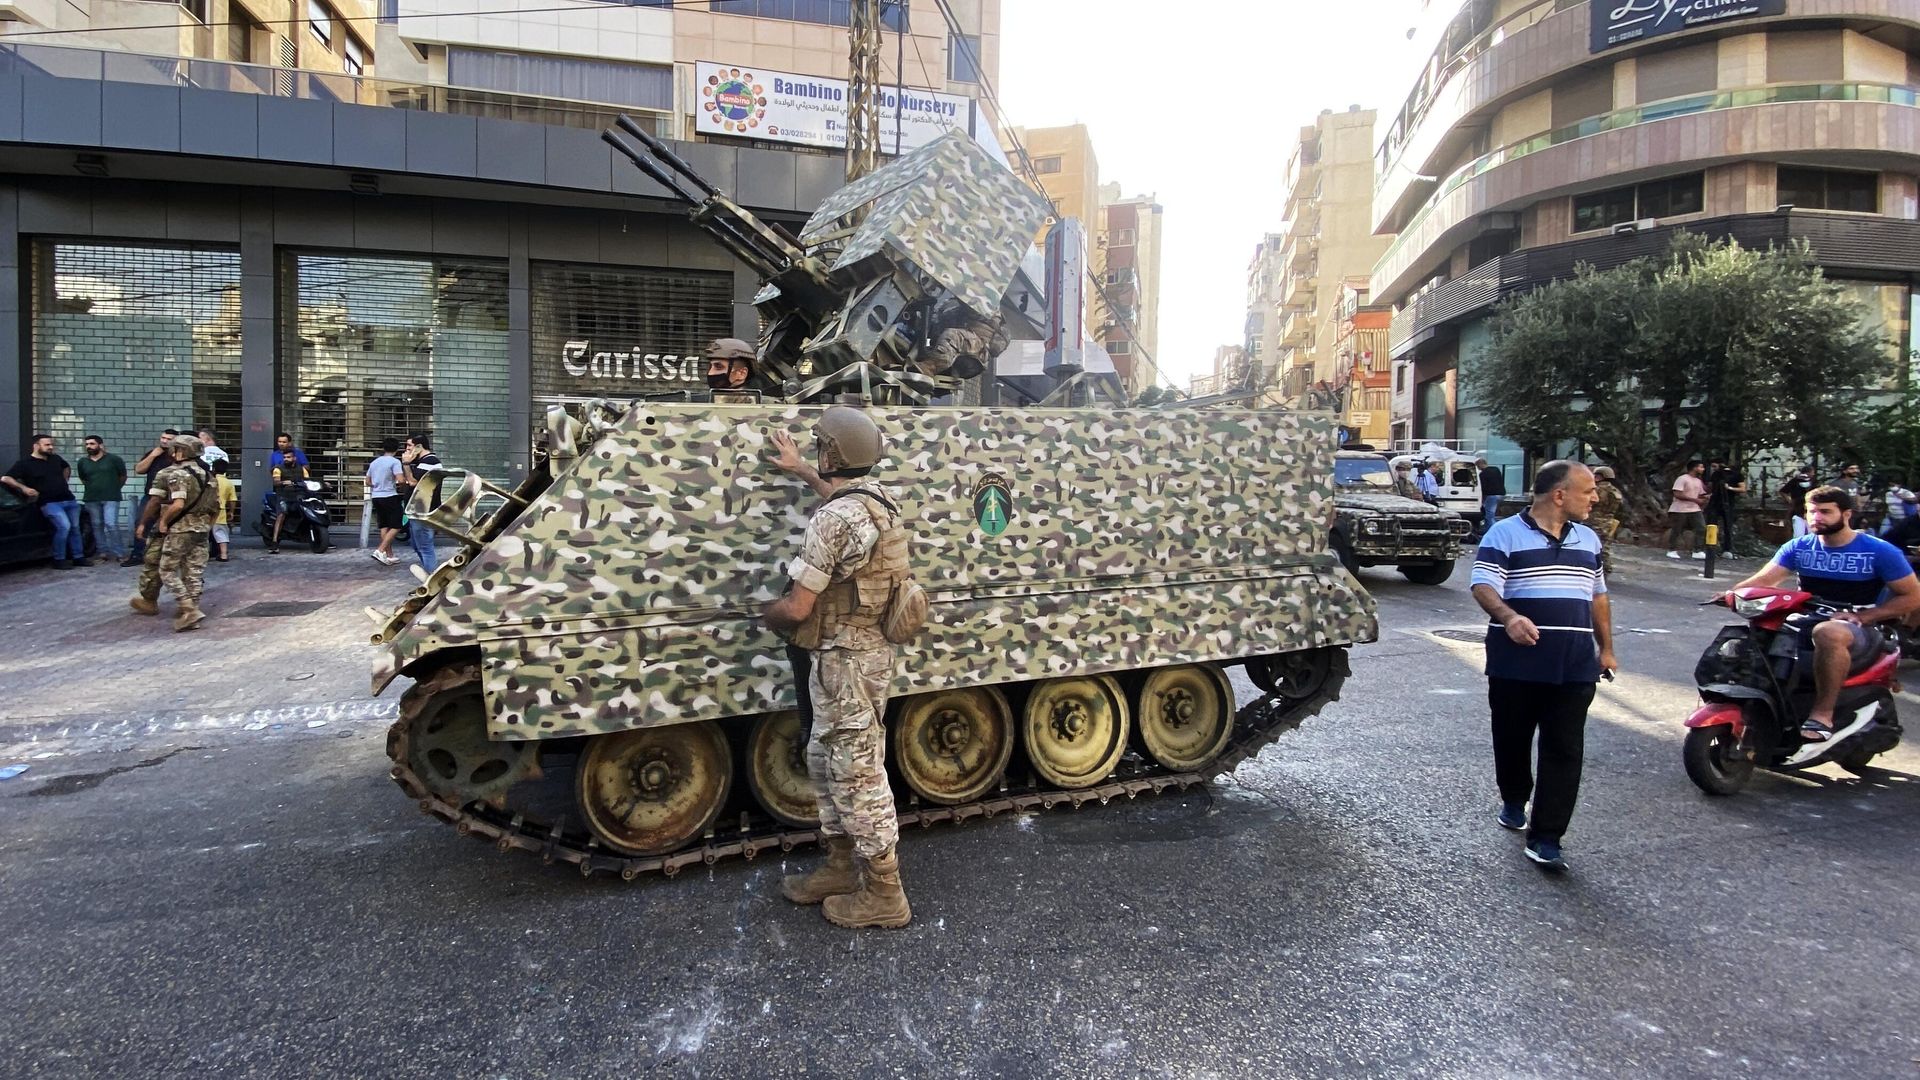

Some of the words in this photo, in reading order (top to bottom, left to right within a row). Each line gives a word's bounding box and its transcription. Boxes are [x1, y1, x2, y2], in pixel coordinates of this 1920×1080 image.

[719, 93, 751, 105] Bambino
[774, 77, 842, 101] Bambino
[899, 94, 956, 117] Nursery
[562, 340, 701, 382] Carissa
